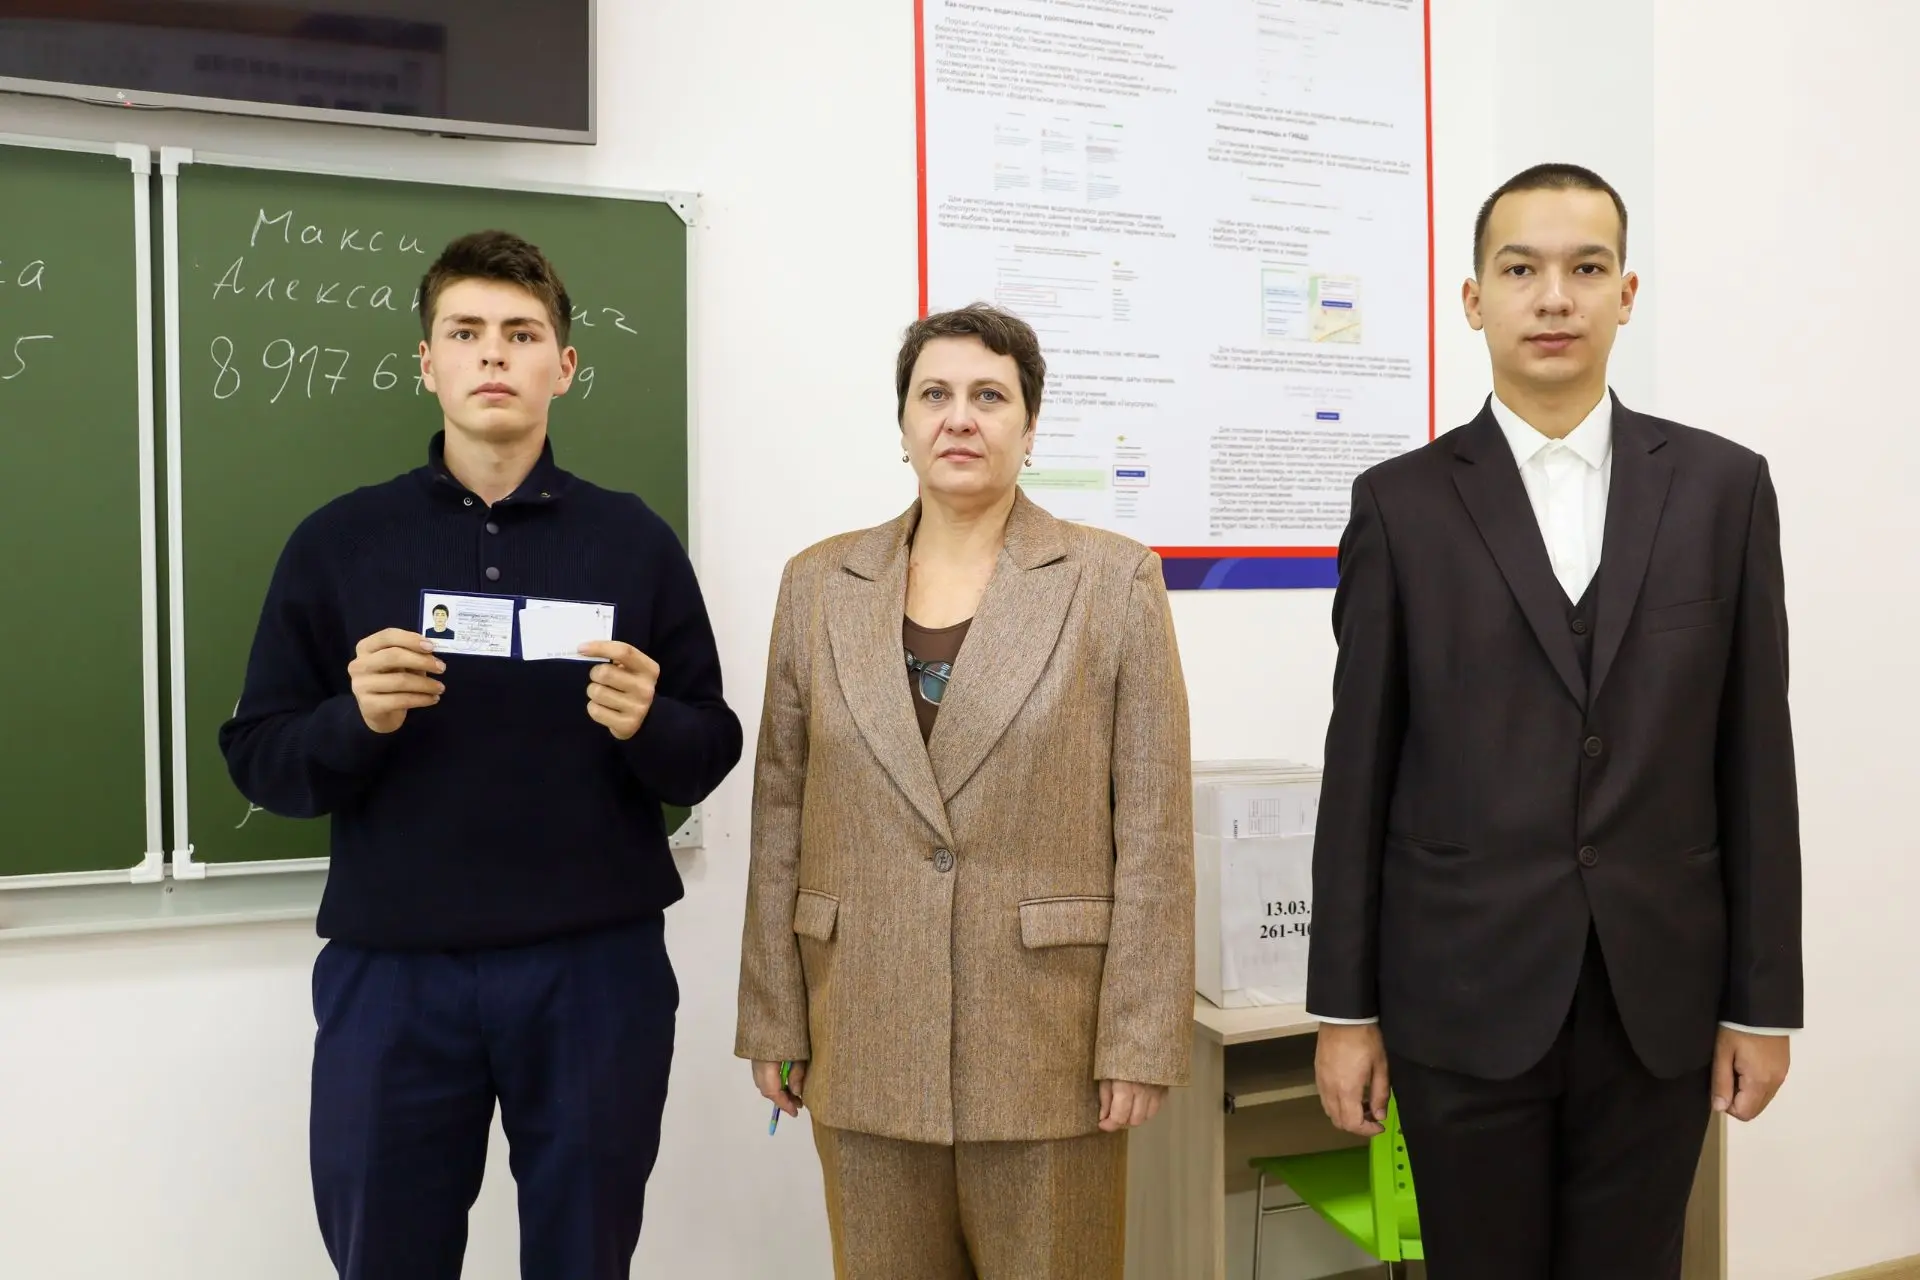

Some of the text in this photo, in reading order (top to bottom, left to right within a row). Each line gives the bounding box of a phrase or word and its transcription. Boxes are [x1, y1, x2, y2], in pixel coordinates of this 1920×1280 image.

[959, 2, 991, 14] получить
[994, 7, 1041, 21] водительское
[1216, 122, 1255, 135] Электронная
[1256, 128, 1281, 138] очередь
[250, 208, 425, 254] Макси
[210, 336, 241, 399] 8
[263, 338, 350, 404] 917
[1266, 900, 1312, 917] 13.03.
